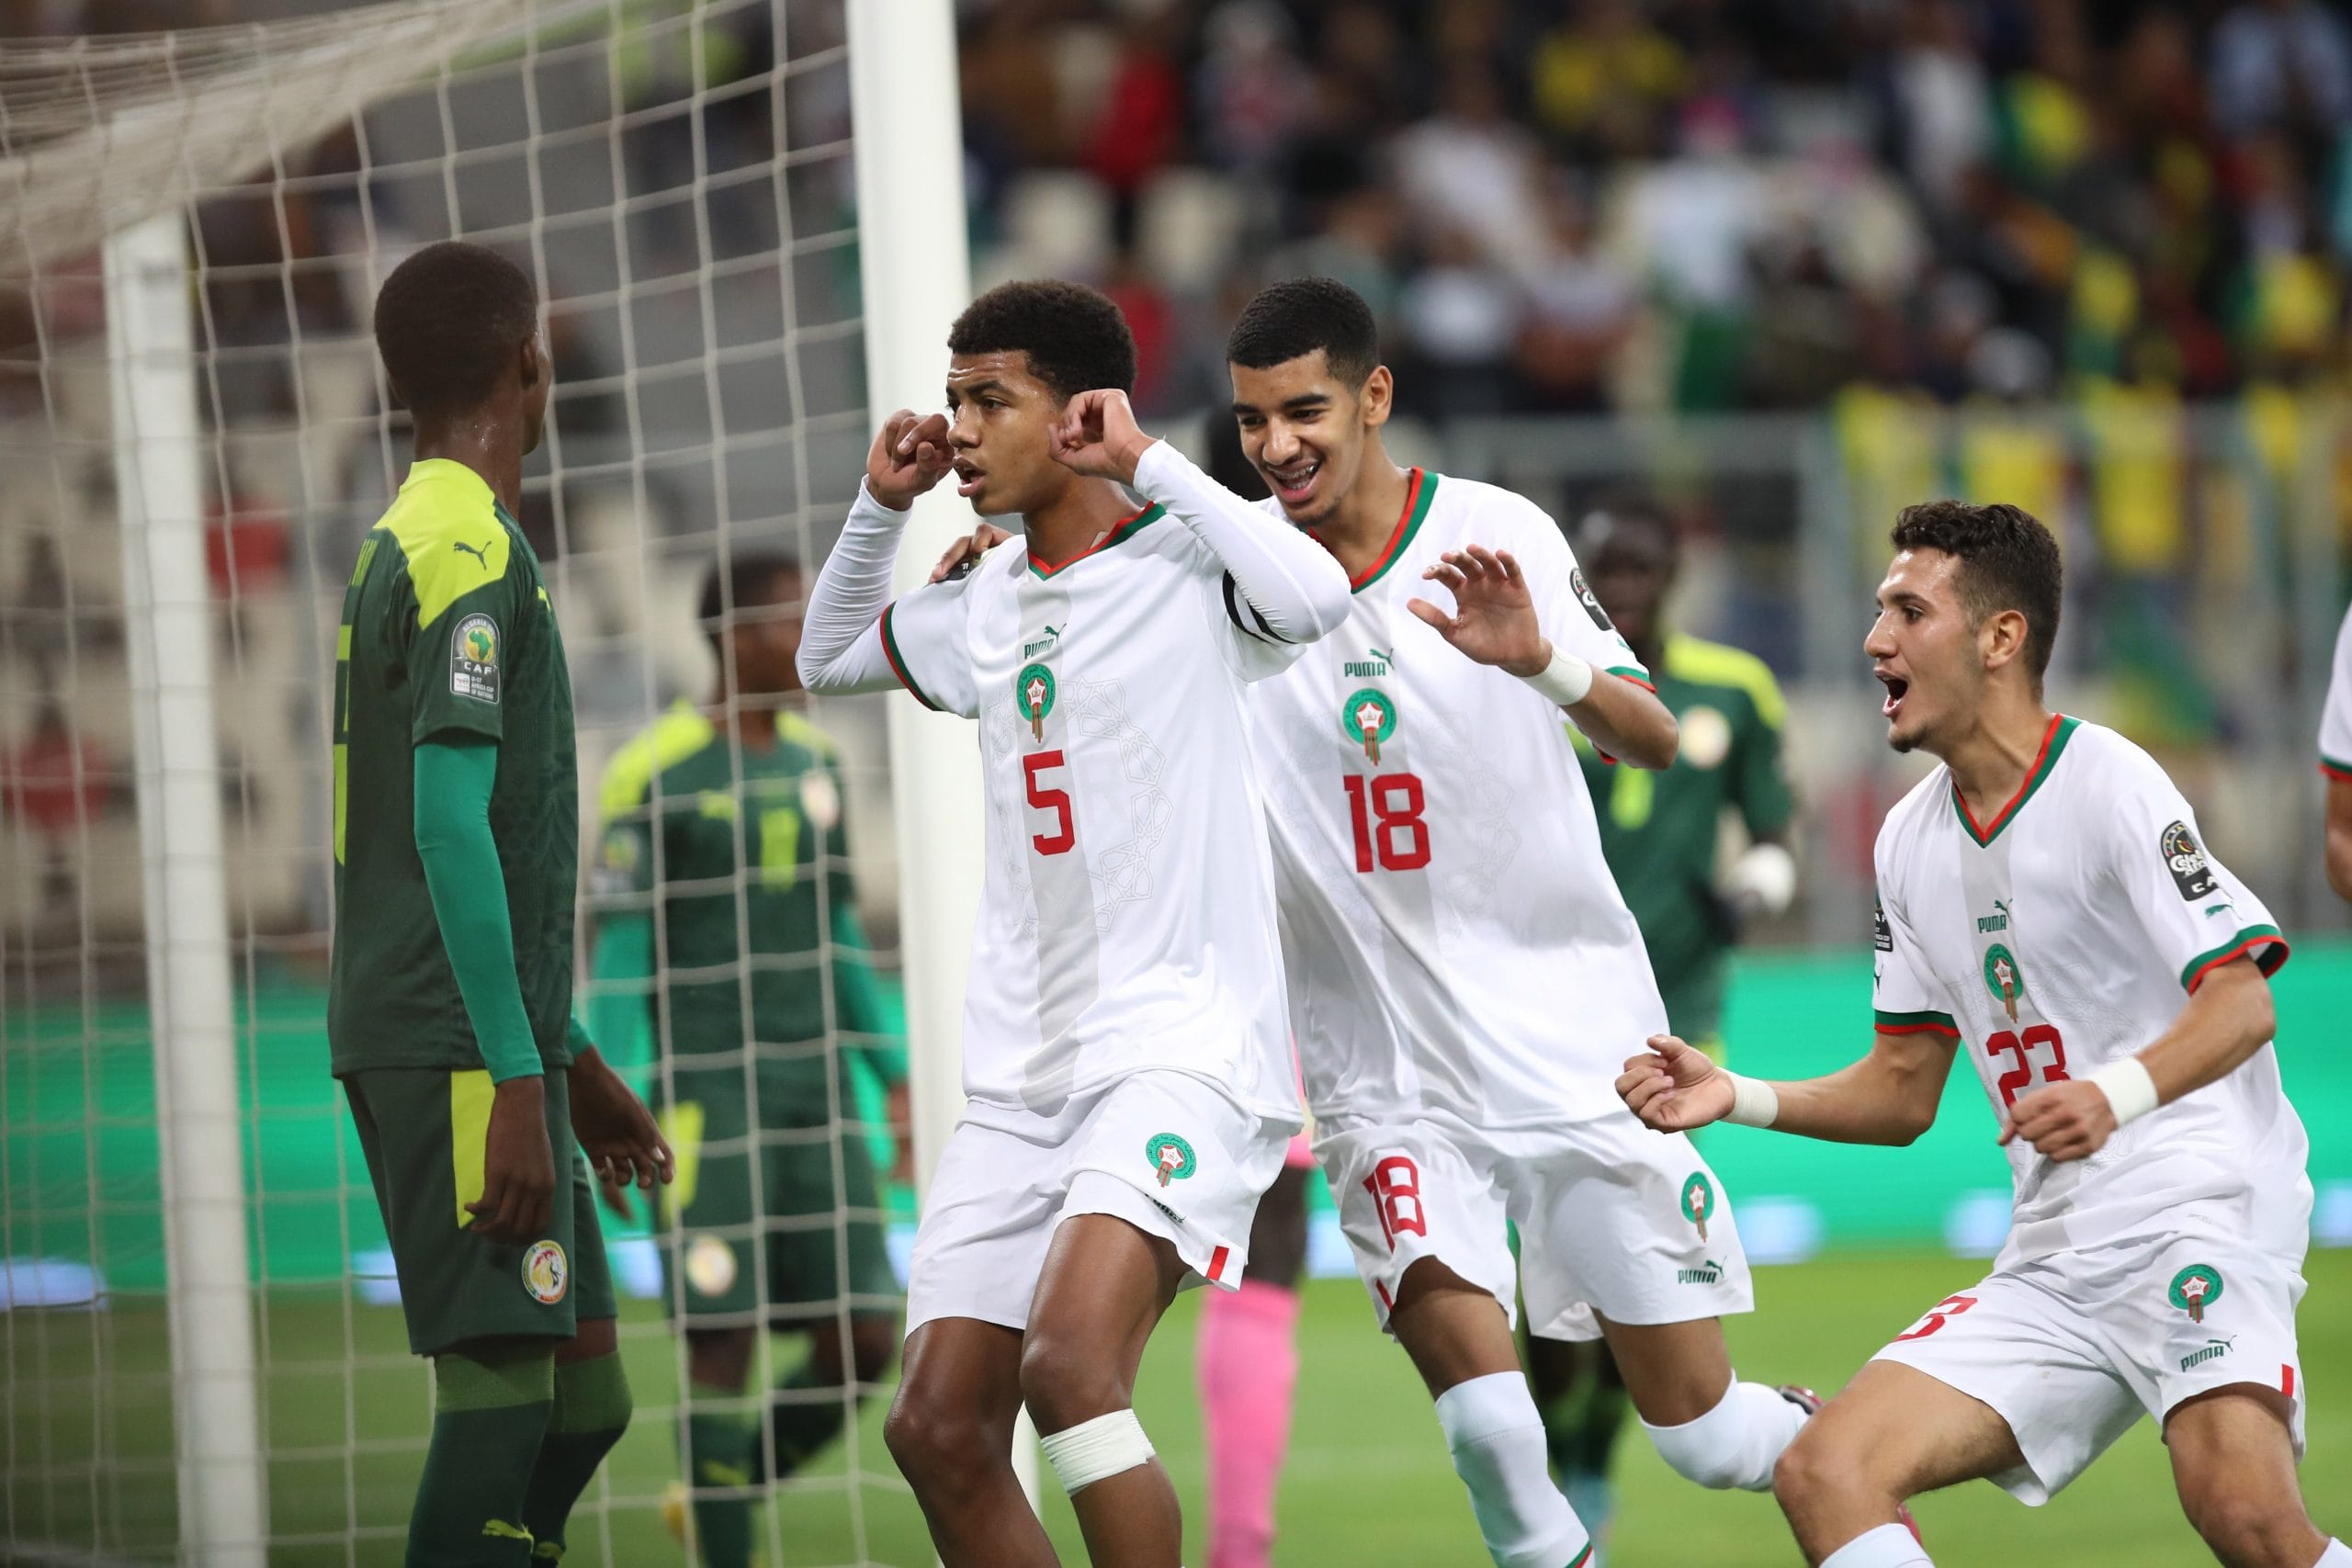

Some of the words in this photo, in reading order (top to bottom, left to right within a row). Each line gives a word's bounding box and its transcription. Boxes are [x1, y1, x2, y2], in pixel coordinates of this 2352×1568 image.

[1023, 638, 1054, 660] PUMA
[464, 661, 492, 674] CAF
[1343, 661, 1386, 678] PUMA
[1023, 750, 1075, 856] 5
[1343, 773, 1431, 873] 18
[1977, 914, 2007, 934] PUMA
[1986, 1024, 2071, 1109] 23
[1362, 1156, 1427, 1256] 18
[1678, 1269, 1717, 1284] PUMA
[2181, 1346, 2224, 1372] PUMA
